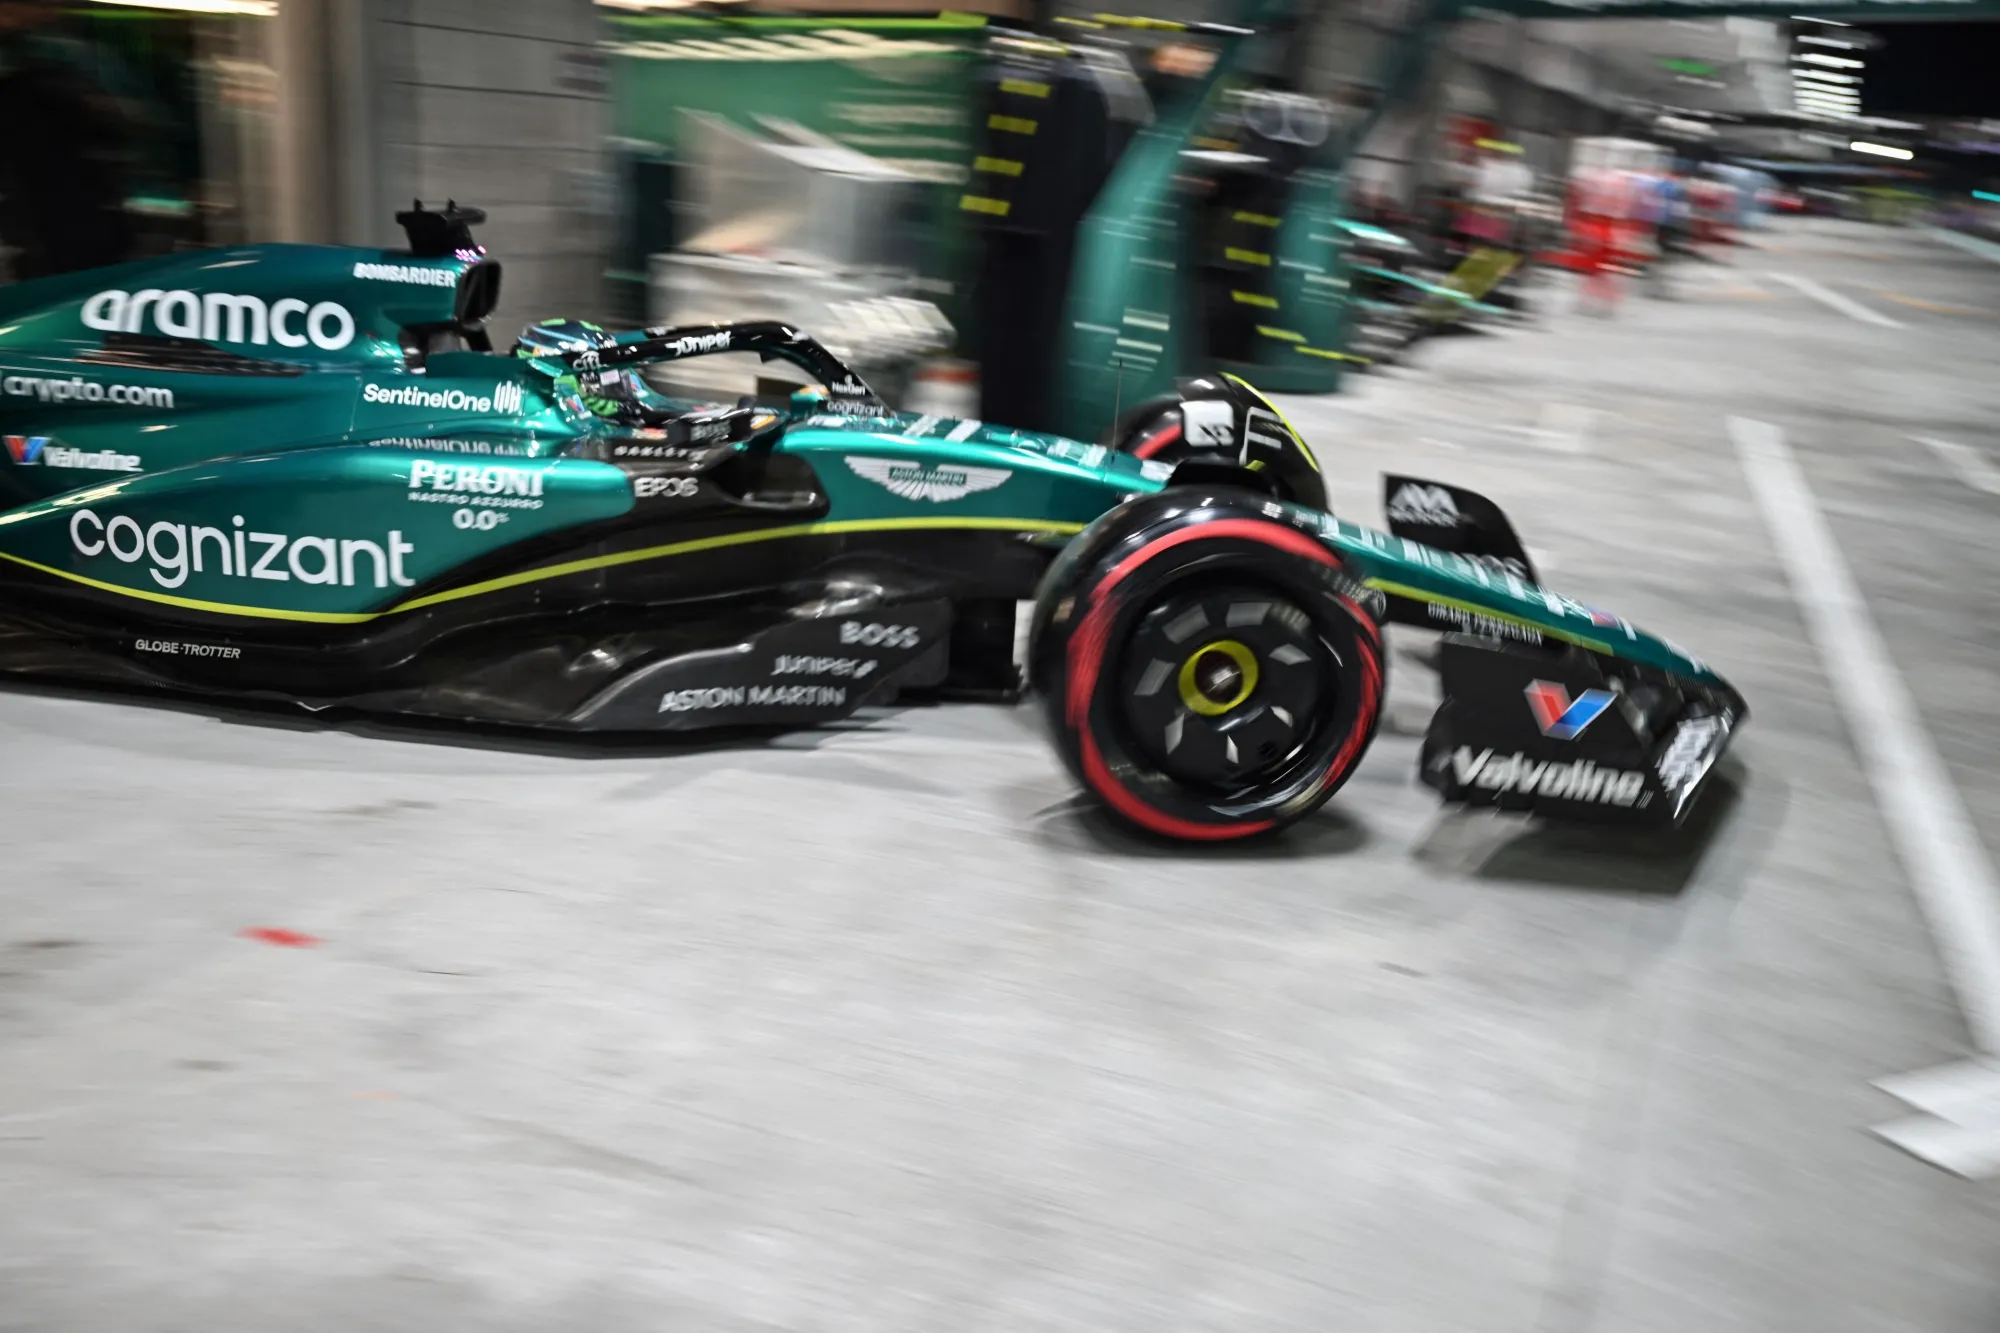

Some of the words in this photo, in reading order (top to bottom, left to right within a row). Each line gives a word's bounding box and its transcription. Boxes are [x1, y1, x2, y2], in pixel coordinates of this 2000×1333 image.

[353, 262, 456, 288] BOMBARDIER
[80, 288, 355, 351] aramco
[3, 375, 174, 408] crypto.com
[363, 383, 492, 412] SentinelOne
[43, 446, 144, 472] Valvoline
[408, 459, 544, 496] PERONI
[634, 477, 699, 497] EPOS
[70, 509, 415, 589] cognizant
[840, 621, 921, 649] BOSS
[658, 686, 746, 713] ASTON
[747, 686, 846, 707] MARTIN
[1452, 745, 1645, 807] Valvoline
